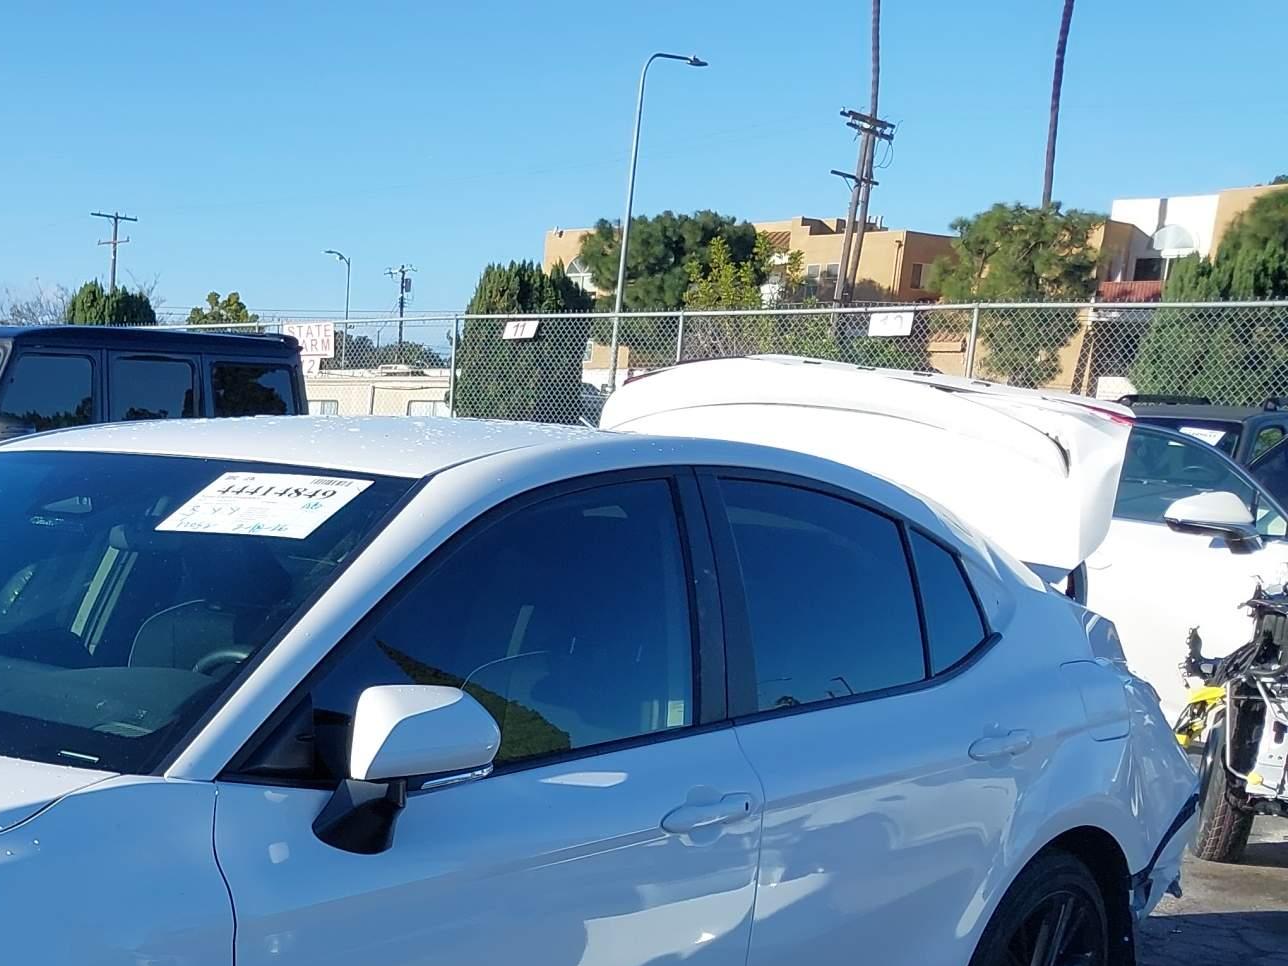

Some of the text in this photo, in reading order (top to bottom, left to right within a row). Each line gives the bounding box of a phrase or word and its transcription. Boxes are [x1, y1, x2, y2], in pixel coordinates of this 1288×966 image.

[287, 324, 332, 338] STATE
[513, 322, 527, 337] 11
[301, 338, 331, 353] ARM
[216, 484, 337, 499] 44414849
